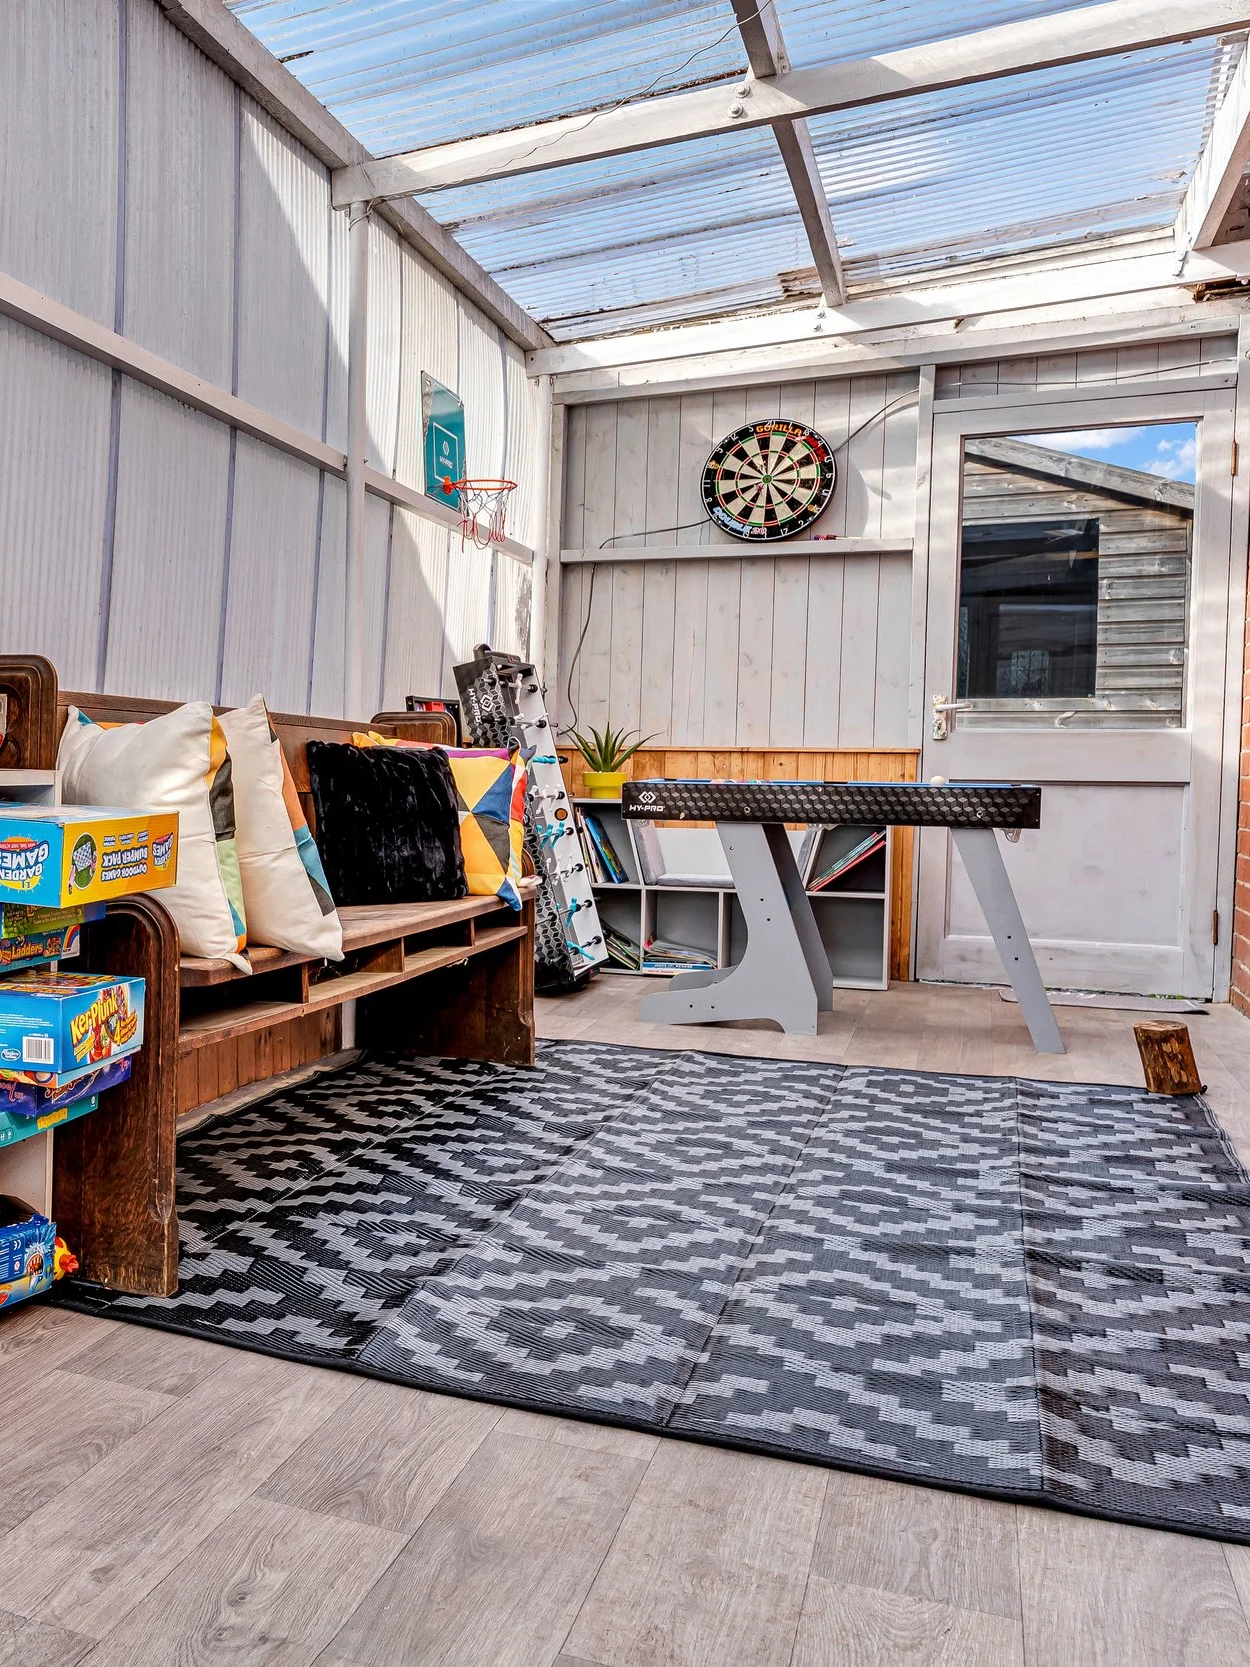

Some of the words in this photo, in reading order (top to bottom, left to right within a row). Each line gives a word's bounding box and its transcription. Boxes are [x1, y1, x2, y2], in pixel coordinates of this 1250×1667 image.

[468, 688, 482, 726] HY-PRO
[629, 804, 664, 812] HY-PRO
[102, 851, 121, 867] PACK
[122, 847, 148, 863] BUMPER
[102, 869, 121, 881] GAMES
[121, 863, 148, 878] OUTDOOR
[11, 943, 44, 959] Ladders
[70, 989, 118, 1047] KerPlunk
[114, 1020, 121, 1046] 4
